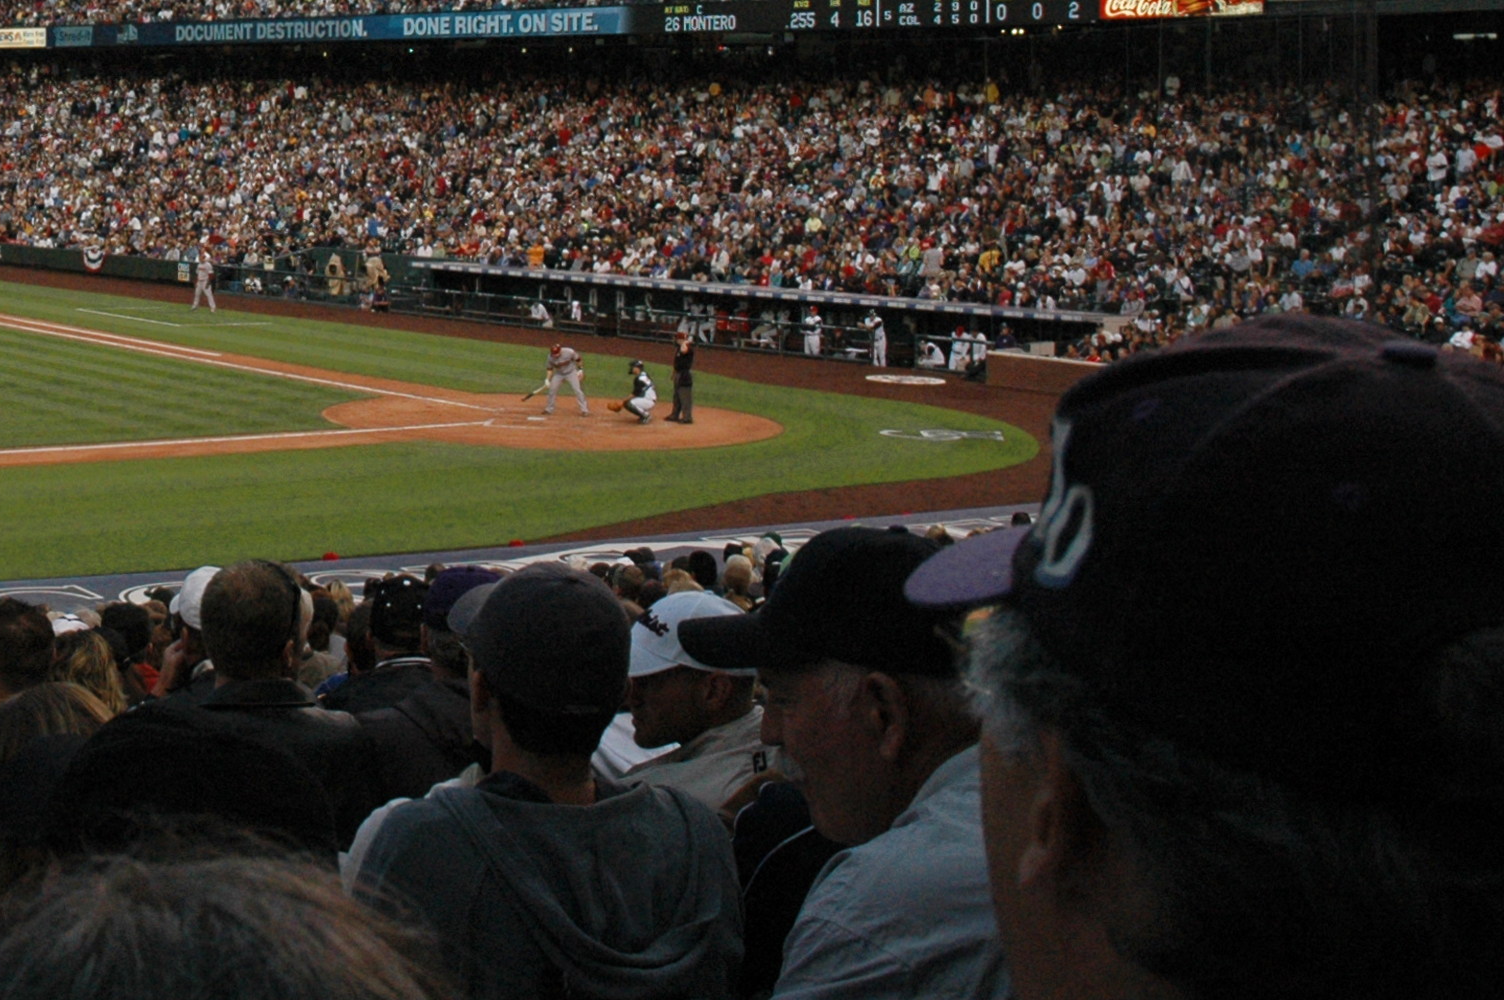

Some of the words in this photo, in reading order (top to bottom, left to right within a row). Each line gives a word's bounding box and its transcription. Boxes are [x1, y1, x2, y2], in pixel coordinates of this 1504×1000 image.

[696, 5, 703, 14] C
[884, 10, 892, 20] 5
[899, 3, 914, 13] AZ
[934, 2, 941, 12] 2
[952, 1, 959, 11] 9
[970, 1, 977, 11] 0
[997, 4, 1007, 21] 0
[1032, 3, 1042, 19] 0
[1068, 1, 1080, 19] 2
[403, 16, 452, 36] DONE
[455, 14, 513, 35] RIGHT.
[518, 13, 547, 33] ON
[550, 12, 599, 32] SITE.
[665, 17, 680, 32] 26
[683, 14, 736, 31] MONTERO
[785, 11, 816, 29] .255
[830, 11, 839, 27] 4
[856, 10, 873, 27] 16
[899, 15, 920, 25] COL
[934, 15, 941, 24] 4
[952, 14, 959, 24] 5
[970, 14, 977, 23] 0
[176, 23, 253, 42] DOCUMENT
[255, 19, 368, 41] DESTRUCTION.
[753, 751, 767, 773] FJ
